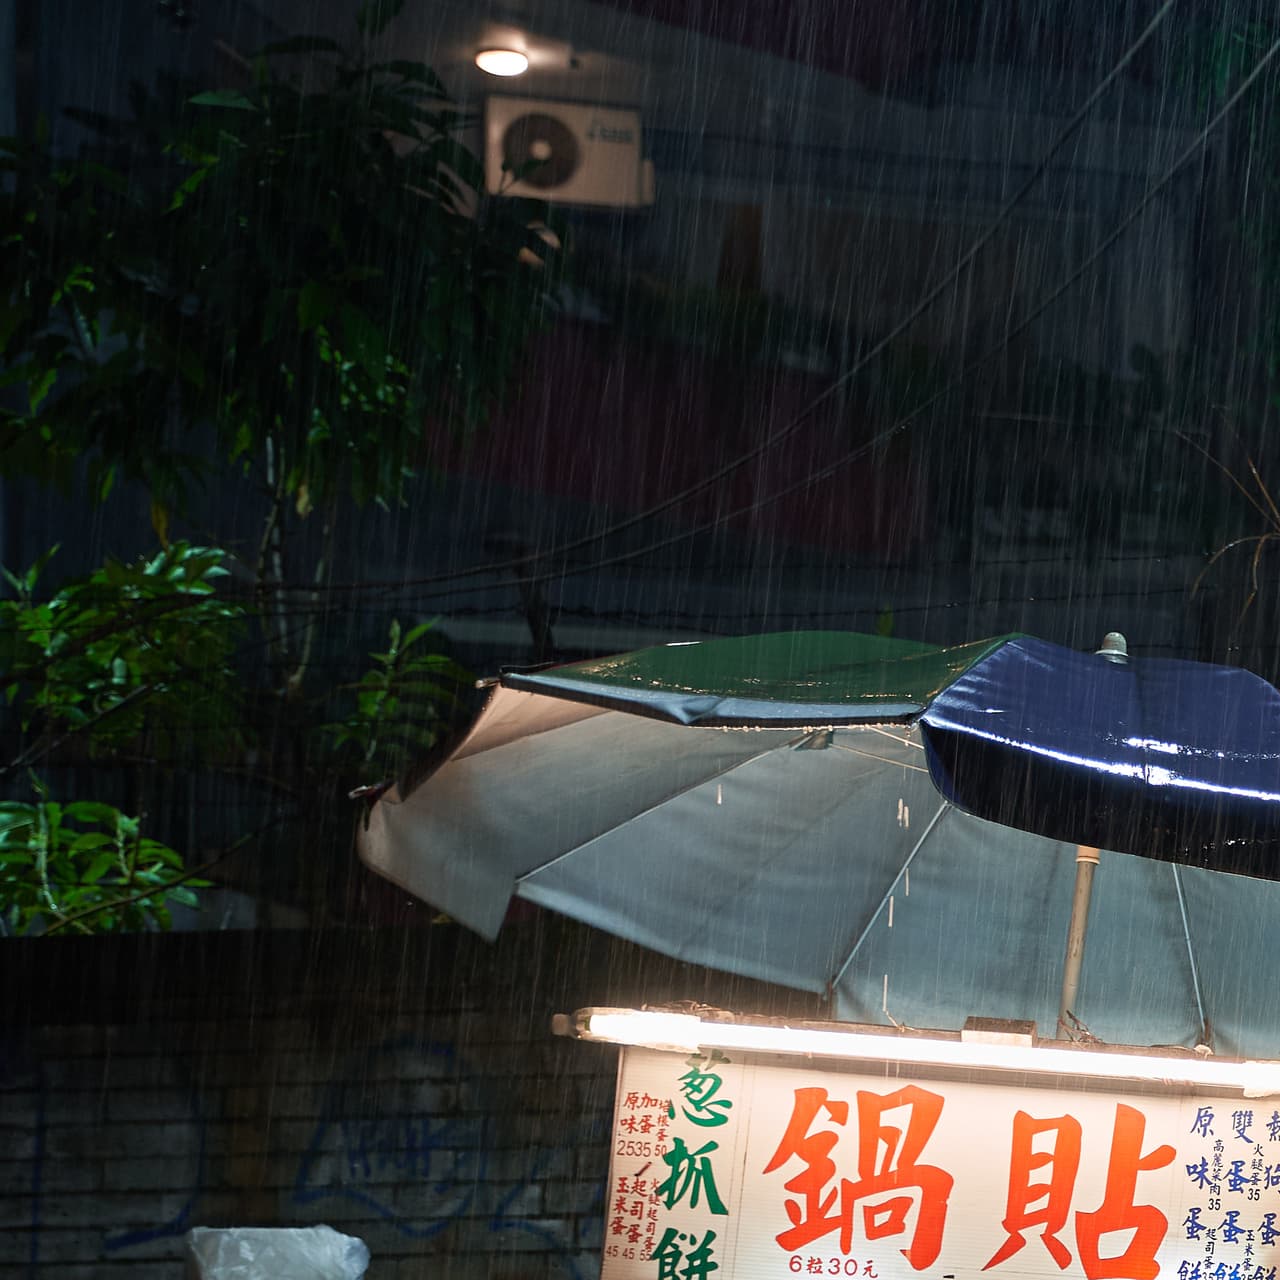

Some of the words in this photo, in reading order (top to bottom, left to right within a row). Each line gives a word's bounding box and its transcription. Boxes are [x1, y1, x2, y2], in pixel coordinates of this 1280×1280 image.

[620, 1091, 639, 1135] 原味
[637, 1092, 659, 1135] 加蛋
[616, 1139, 634, 1157] 25
[633, 1141, 651, 1157] 35
[654, 1144, 668, 1157] 50
[1209, 1139, 1225, 1196] 高麗菜肉
[1249, 1143, 1264, 1186] 火腿蛋
[609, 1177, 630, 1236] 玉米蛋
[1207, 1198, 1221, 1211] 35
[1247, 1188, 1260, 1201] 35
[625, 1178, 648, 1244] 起司蛋
[606, 1245, 619, 1257] 45
[622, 1247, 635, 1260] 45
[639, 1248, 652, 1261] 55
[1202, 1228, 1217, 1269] 起司蛋
[1241, 1229, 1256, 1271] 玉米蛋
[788, 1255, 879, 1279] 6粒30元
